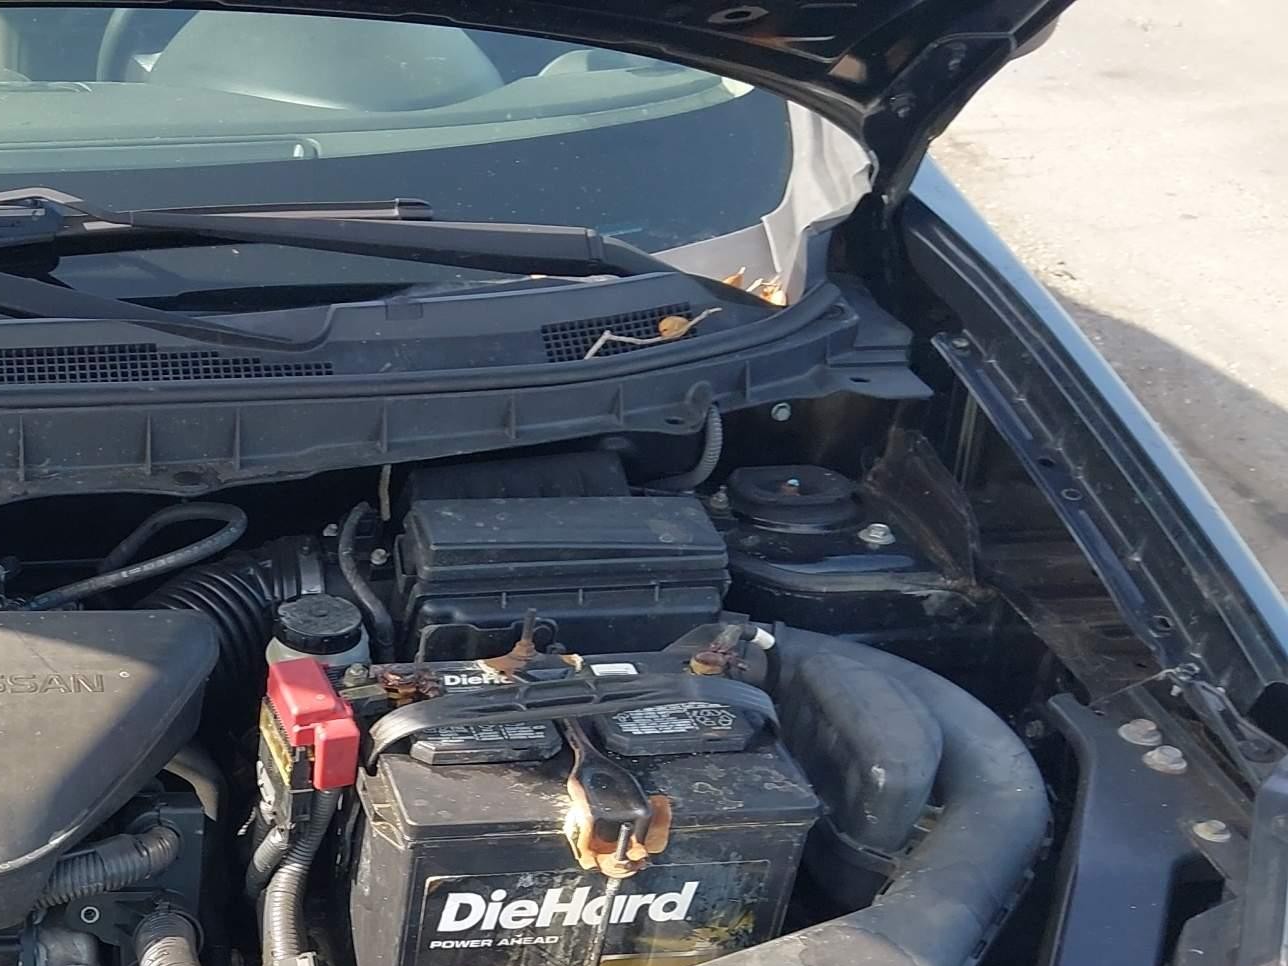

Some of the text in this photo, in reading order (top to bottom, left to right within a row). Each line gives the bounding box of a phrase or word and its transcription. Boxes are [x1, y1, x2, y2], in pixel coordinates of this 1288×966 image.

[437, 881, 700, 932] DieHard
[429, 935, 560, 949] POWER AHEAD
